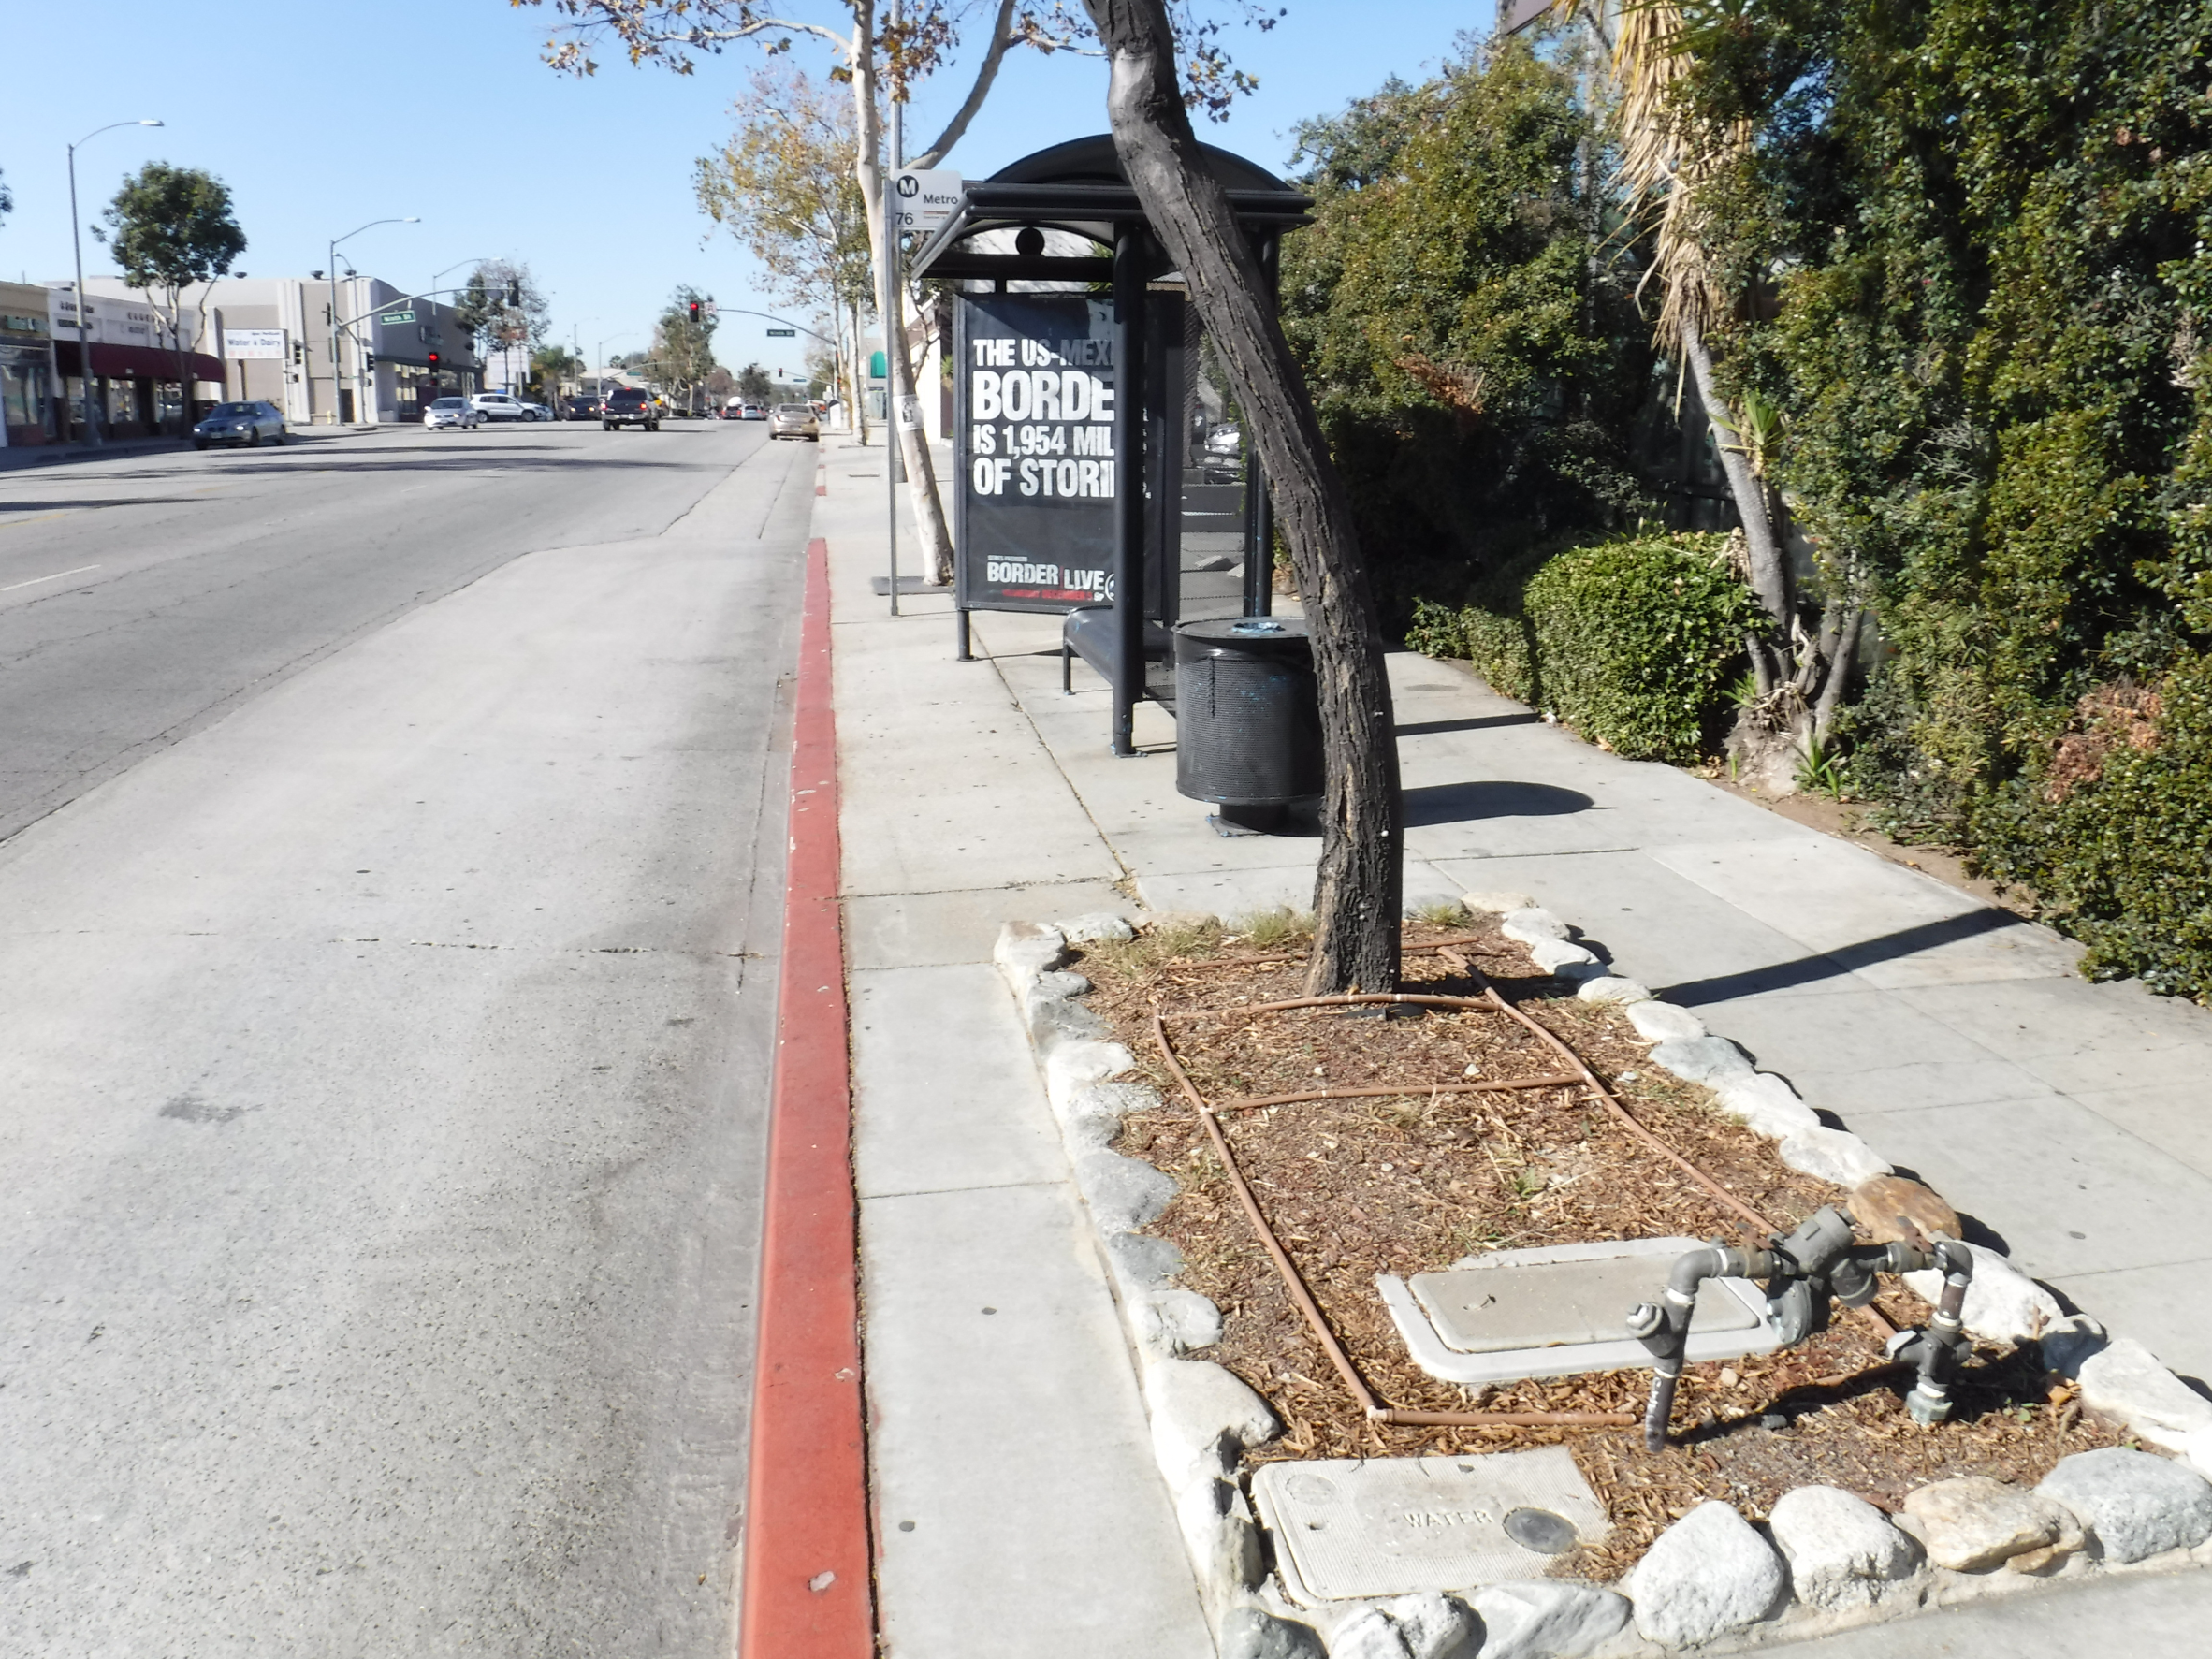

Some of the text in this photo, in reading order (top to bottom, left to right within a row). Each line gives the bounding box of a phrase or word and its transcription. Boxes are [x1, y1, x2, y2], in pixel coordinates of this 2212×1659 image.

[923, 194, 959, 205] Metro
[895, 212, 914, 226] 76
[227, 338, 250, 346] Water
[260, 338, 281, 347] Dairy
[973, 338, 1114, 367] THE US-MEXI
[973, 371, 1115, 421] BORDE
[973, 424, 1115, 459] IS 1,954 MIL
[973, 458, 1115, 498] OF STORI
[987, 561, 1105, 591] BORDER LIVE
[1403, 1509, 1497, 1529] WATER
